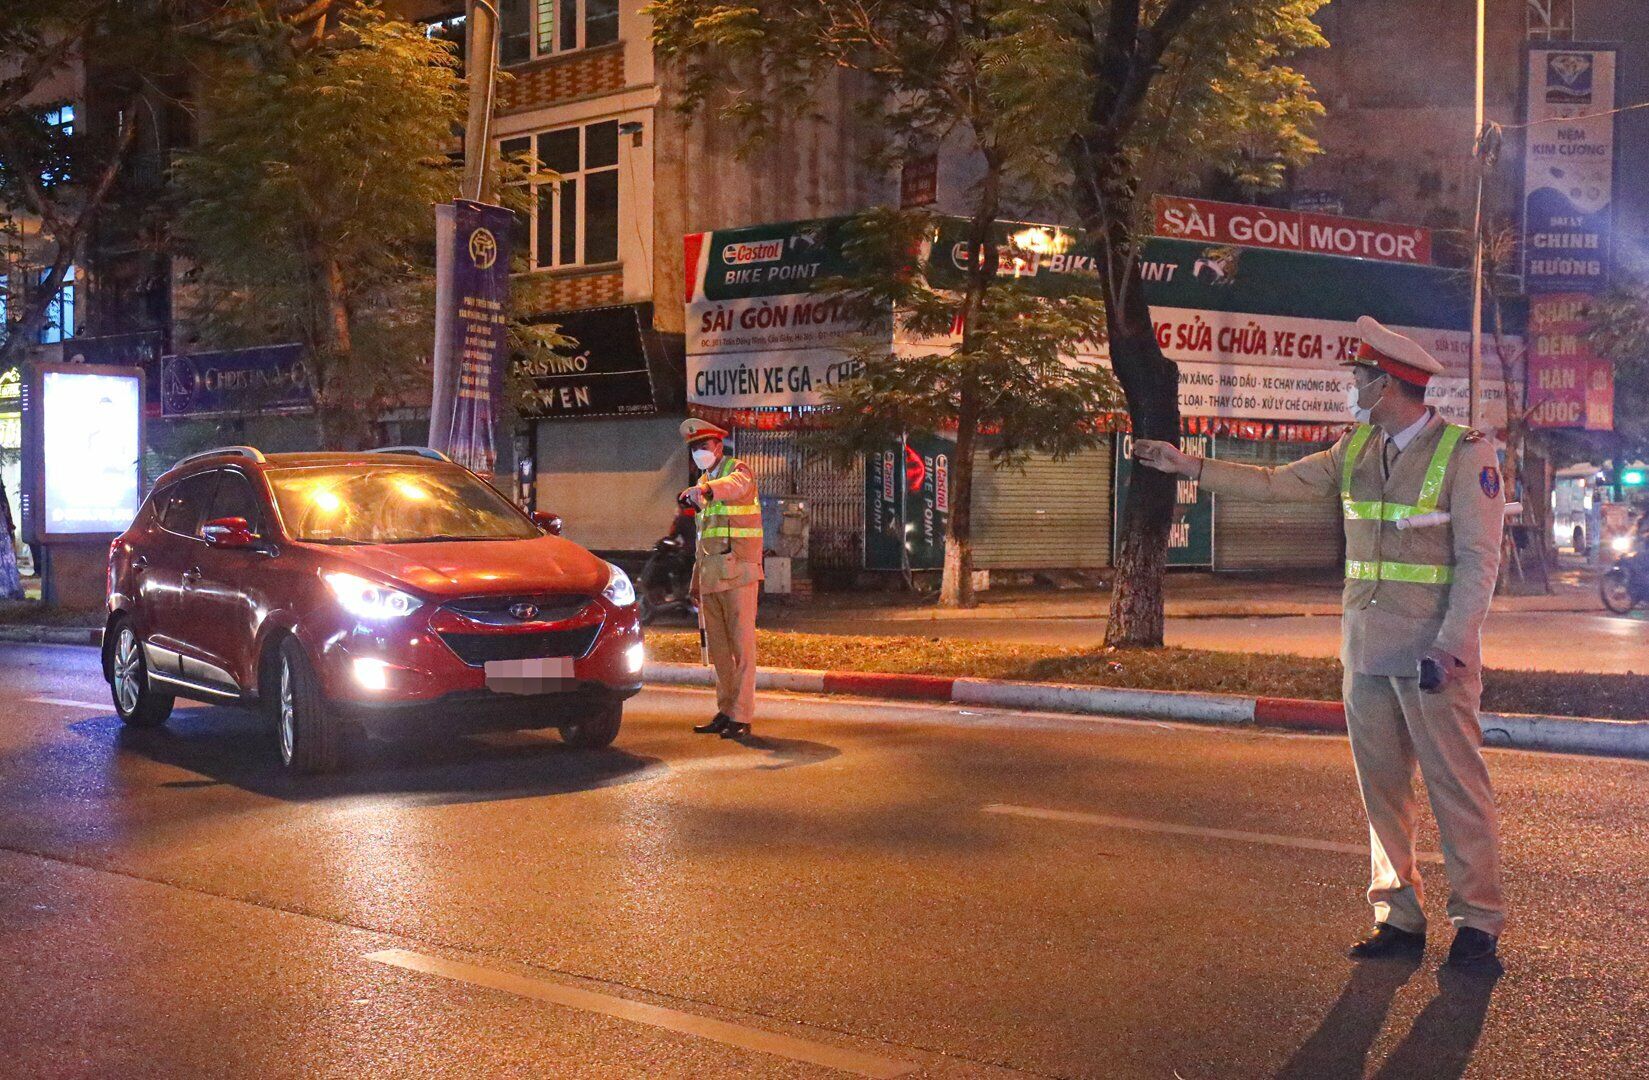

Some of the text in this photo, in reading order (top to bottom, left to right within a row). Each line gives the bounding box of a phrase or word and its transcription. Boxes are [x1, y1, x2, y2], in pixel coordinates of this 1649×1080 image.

[1533, 143, 1556, 155] KIM
[1162, 203, 1417, 260] SÀI GÒN MOTOR
[736, 243, 780, 262] Castrol
[725, 263, 821, 285] BIKE POINT
[701, 305, 734, 333] SÀI
[740, 301, 788, 330] GÒN
[1175, 315, 1212, 351] SỬA
[1218, 321, 1267, 355] CHỮA
[1271, 331, 1296, 357] XE
[1298, 334, 1322, 360] GA
[695, 363, 759, 397] CHUYÊN
[763, 367, 784, 394] XE
[788, 365, 812, 393] GA
[1190, 371, 1214, 386] XĂNG
[1220, 375, 1238, 387] HAO
[1262, 377, 1273, 389] XE
[1296, 378, 1324, 392] KHÔNG
[1184, 394, 1204, 410] LOẠI
[1209, 395, 1231, 408] THAY
[1324, 399, 1345, 413] XĂNG
[925, 456, 934, 547] BIKE POINT
[937, 467, 948, 510] Castrol
[873, 489, 883, 533] POINT
